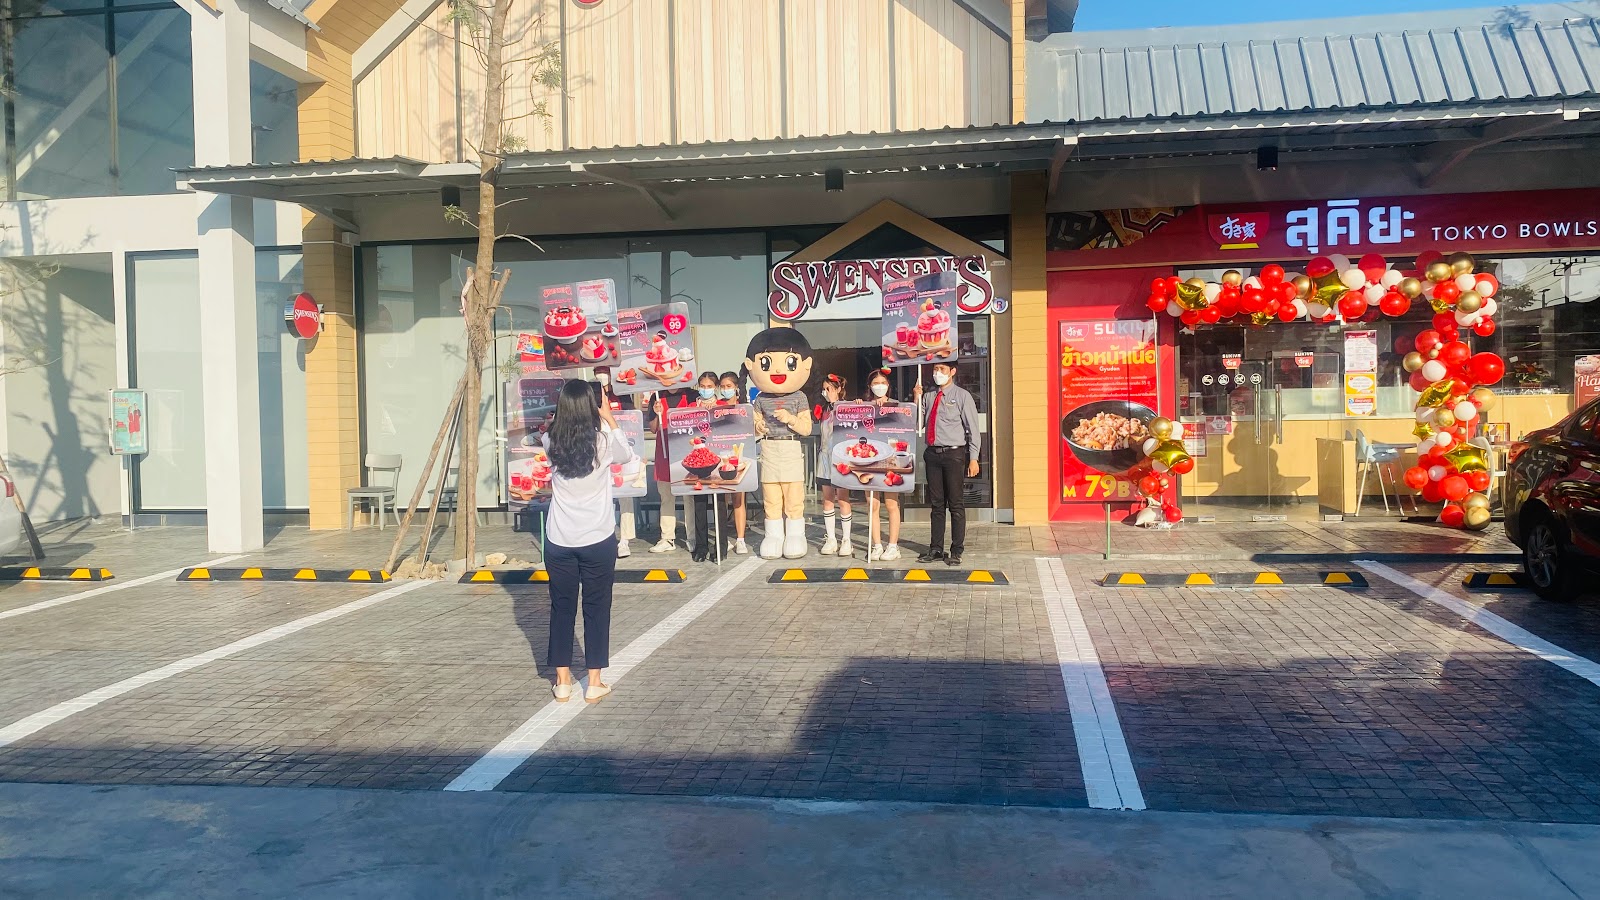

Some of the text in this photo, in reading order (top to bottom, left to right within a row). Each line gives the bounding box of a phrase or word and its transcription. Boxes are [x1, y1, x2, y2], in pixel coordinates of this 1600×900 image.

[1220, 216, 1257, 241] すき家
[1286, 199, 1415, 254] สุคิยะ
[1431, 220, 1598, 241] TOKYO BOWLS
[669, 321, 682, 330] 99
[1099, 365, 1120, 373] Gyudon
[1063, 485, 1077, 498] M
